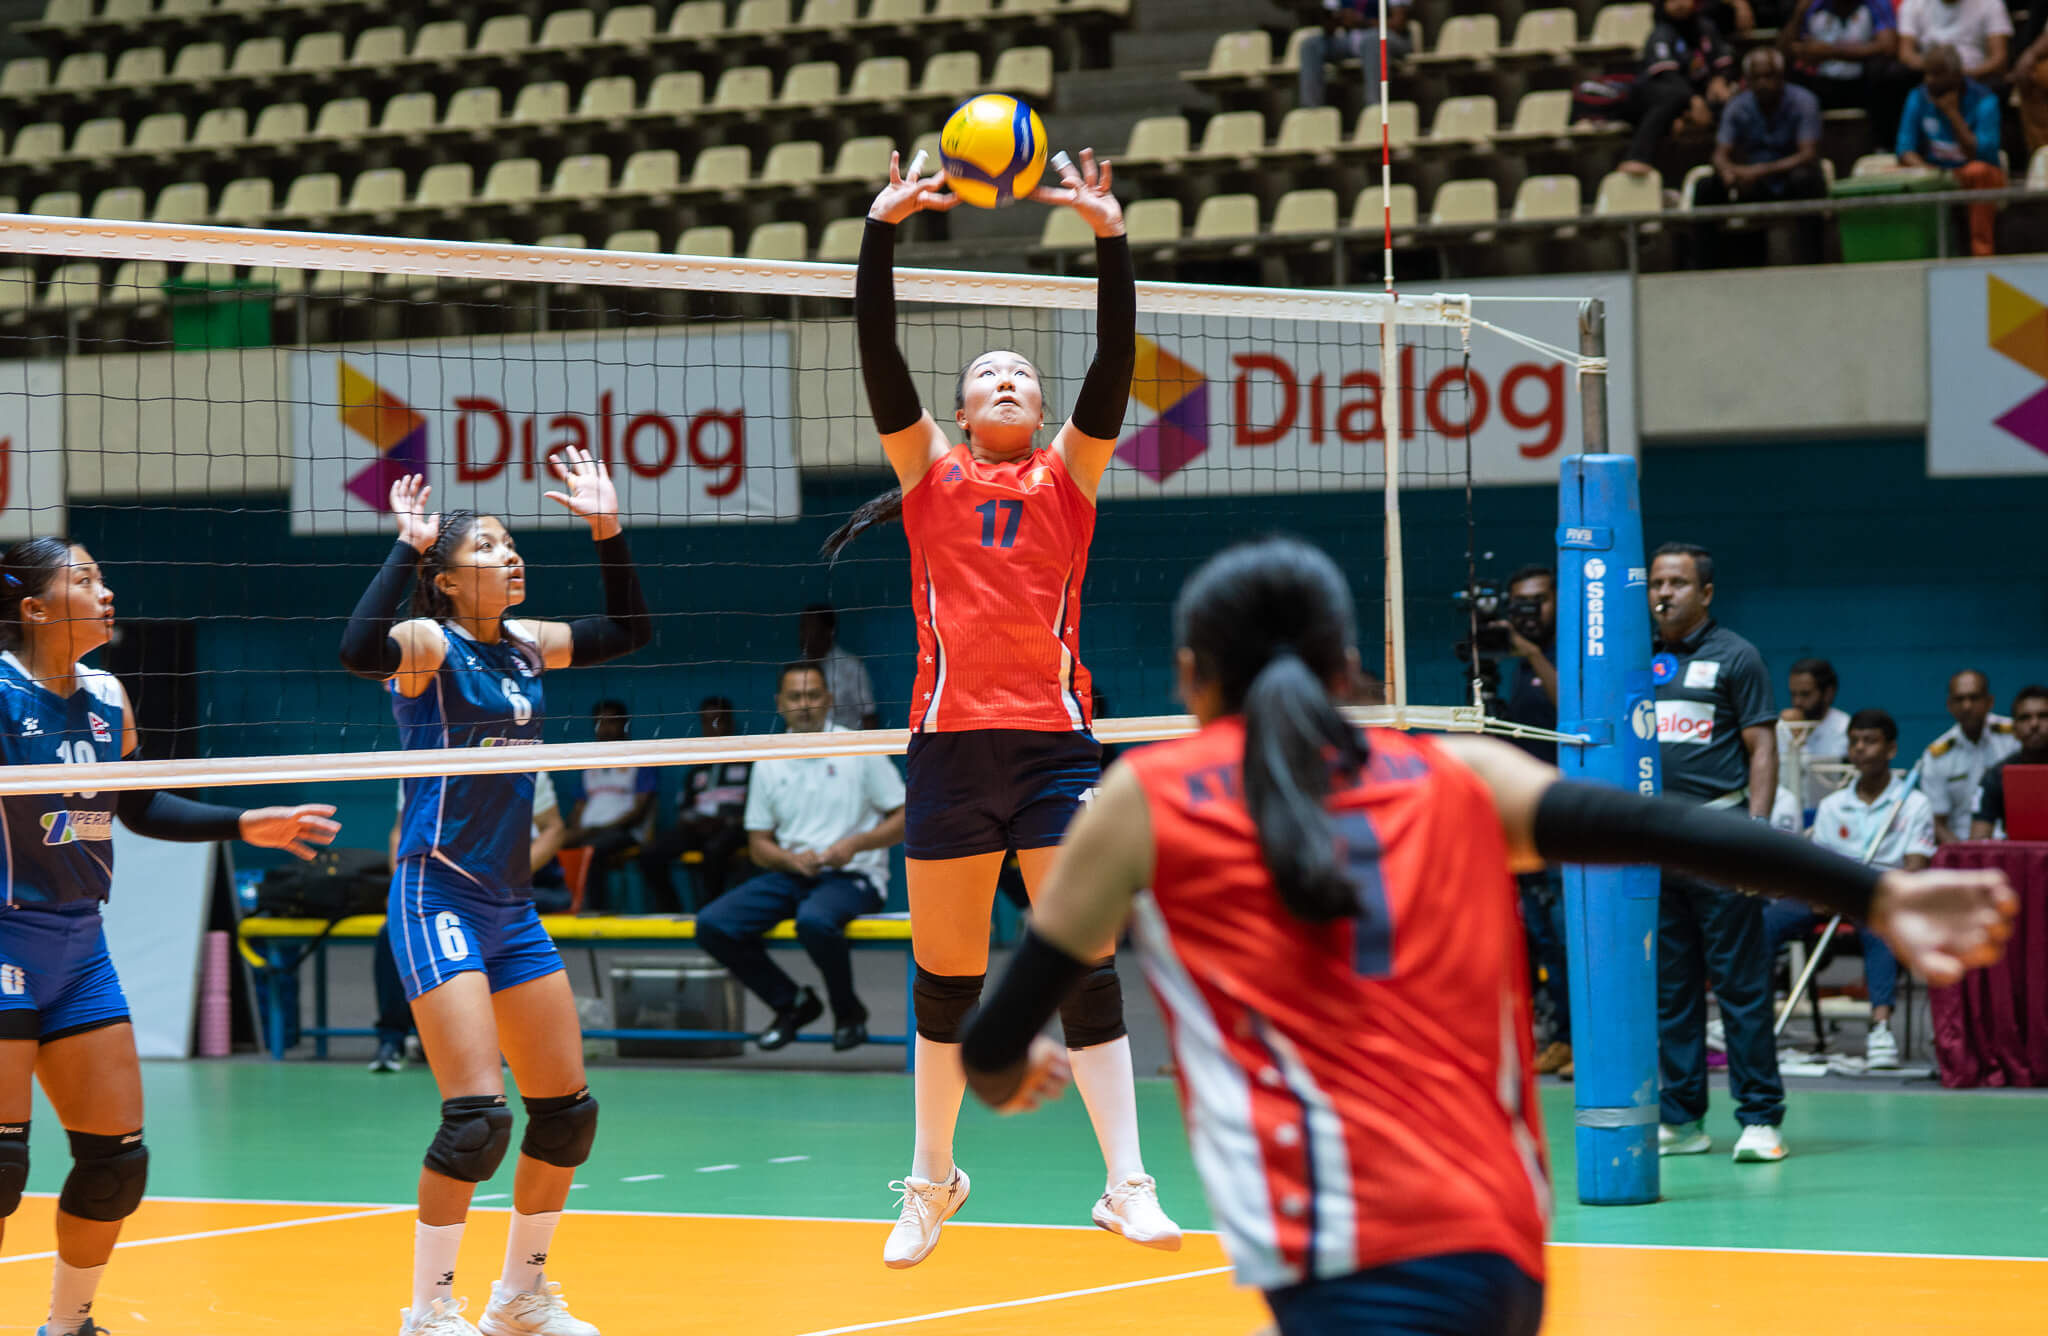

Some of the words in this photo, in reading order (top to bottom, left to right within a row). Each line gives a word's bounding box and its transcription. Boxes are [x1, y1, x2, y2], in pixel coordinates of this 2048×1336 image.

[1232, 343, 1565, 459] Dialog
[453, 388, 746, 498] Dialog
[976, 500, 1024, 548] 17
[501, 678, 532, 726] 6
[1656, 713, 1713, 739] alog
[435, 911, 468, 961] 6
